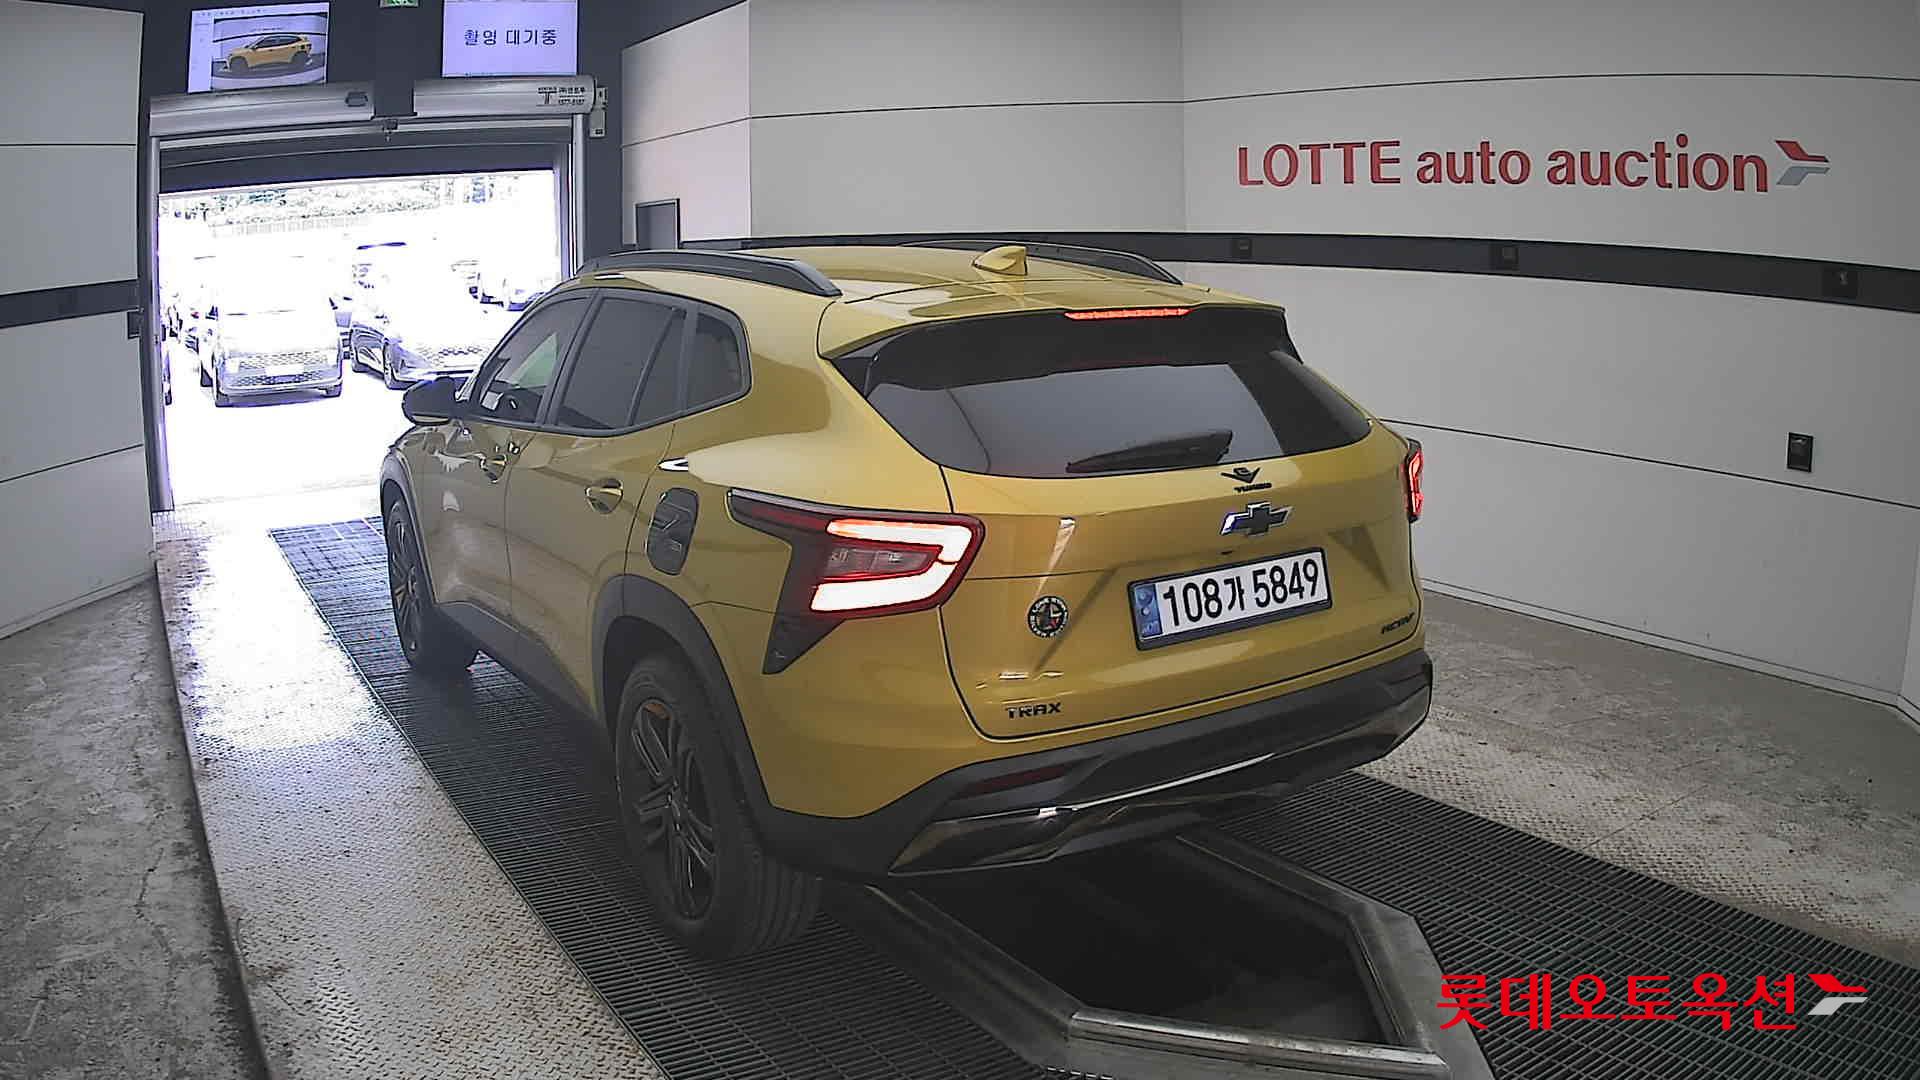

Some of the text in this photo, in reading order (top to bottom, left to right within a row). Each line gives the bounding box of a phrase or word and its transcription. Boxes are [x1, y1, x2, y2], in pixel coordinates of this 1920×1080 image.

[505, 28, 557, 46] 대기중
[1238, 133, 1769, 193] LOTTE auto auction
[1163, 558, 1319, 627] 108가 5849
[1005, 702, 1062, 719] TRAX
